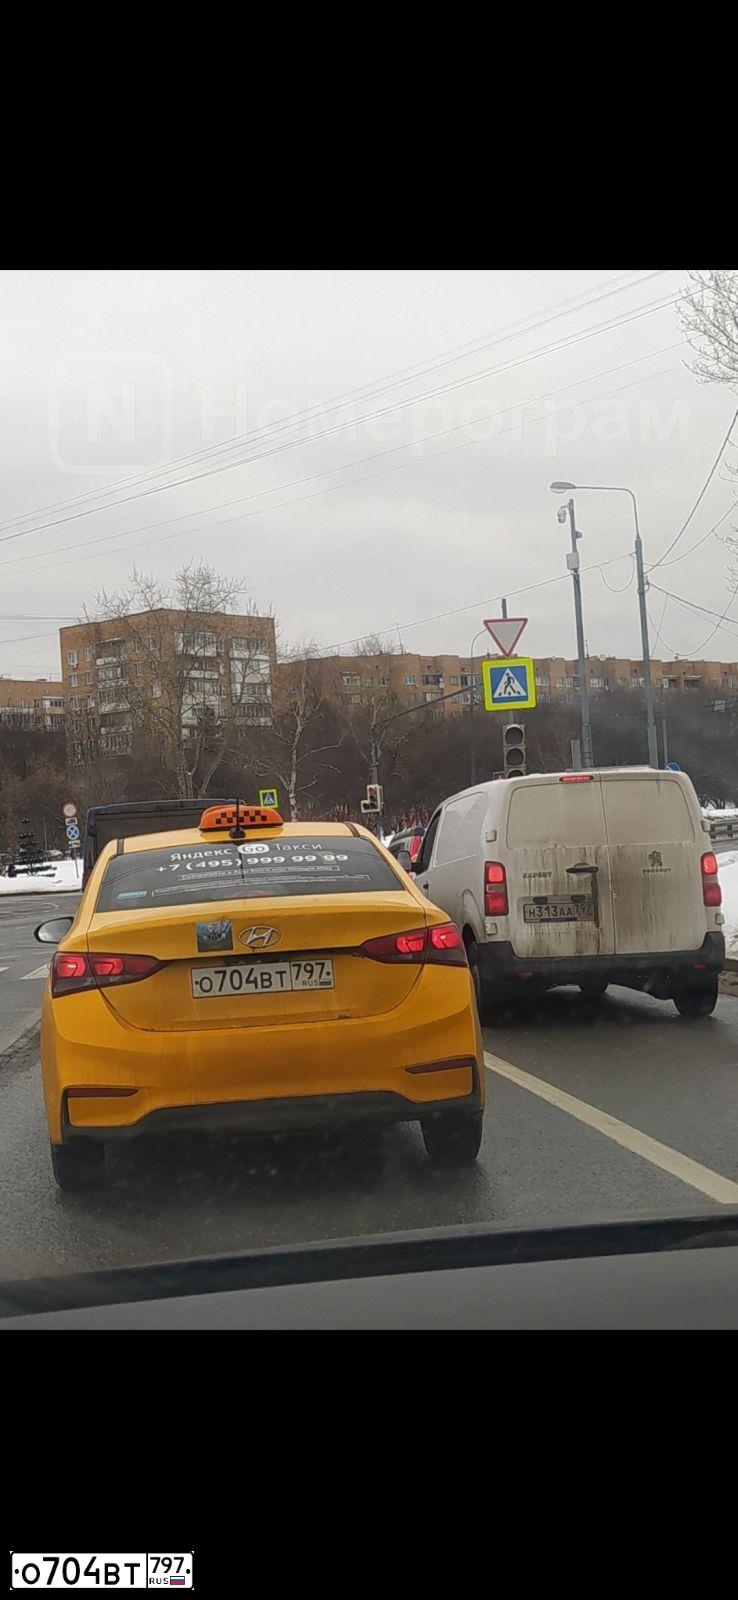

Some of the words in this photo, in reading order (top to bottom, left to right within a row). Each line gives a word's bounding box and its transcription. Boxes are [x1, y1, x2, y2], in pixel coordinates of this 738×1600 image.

[170, 848, 233, 862] Яндекс
[241, 844, 266, 853] Go
[272, 843, 323, 851] Такси
[155, 863, 181, 873] +7
[186, 858, 242, 871] (495)
[246, 856, 286, 865] 999
[291, 854, 317, 863] 99
[323, 853, 349, 862] 99
[199, 967, 287, 993] О704ВТ
[291, 962, 325, 981] 797
